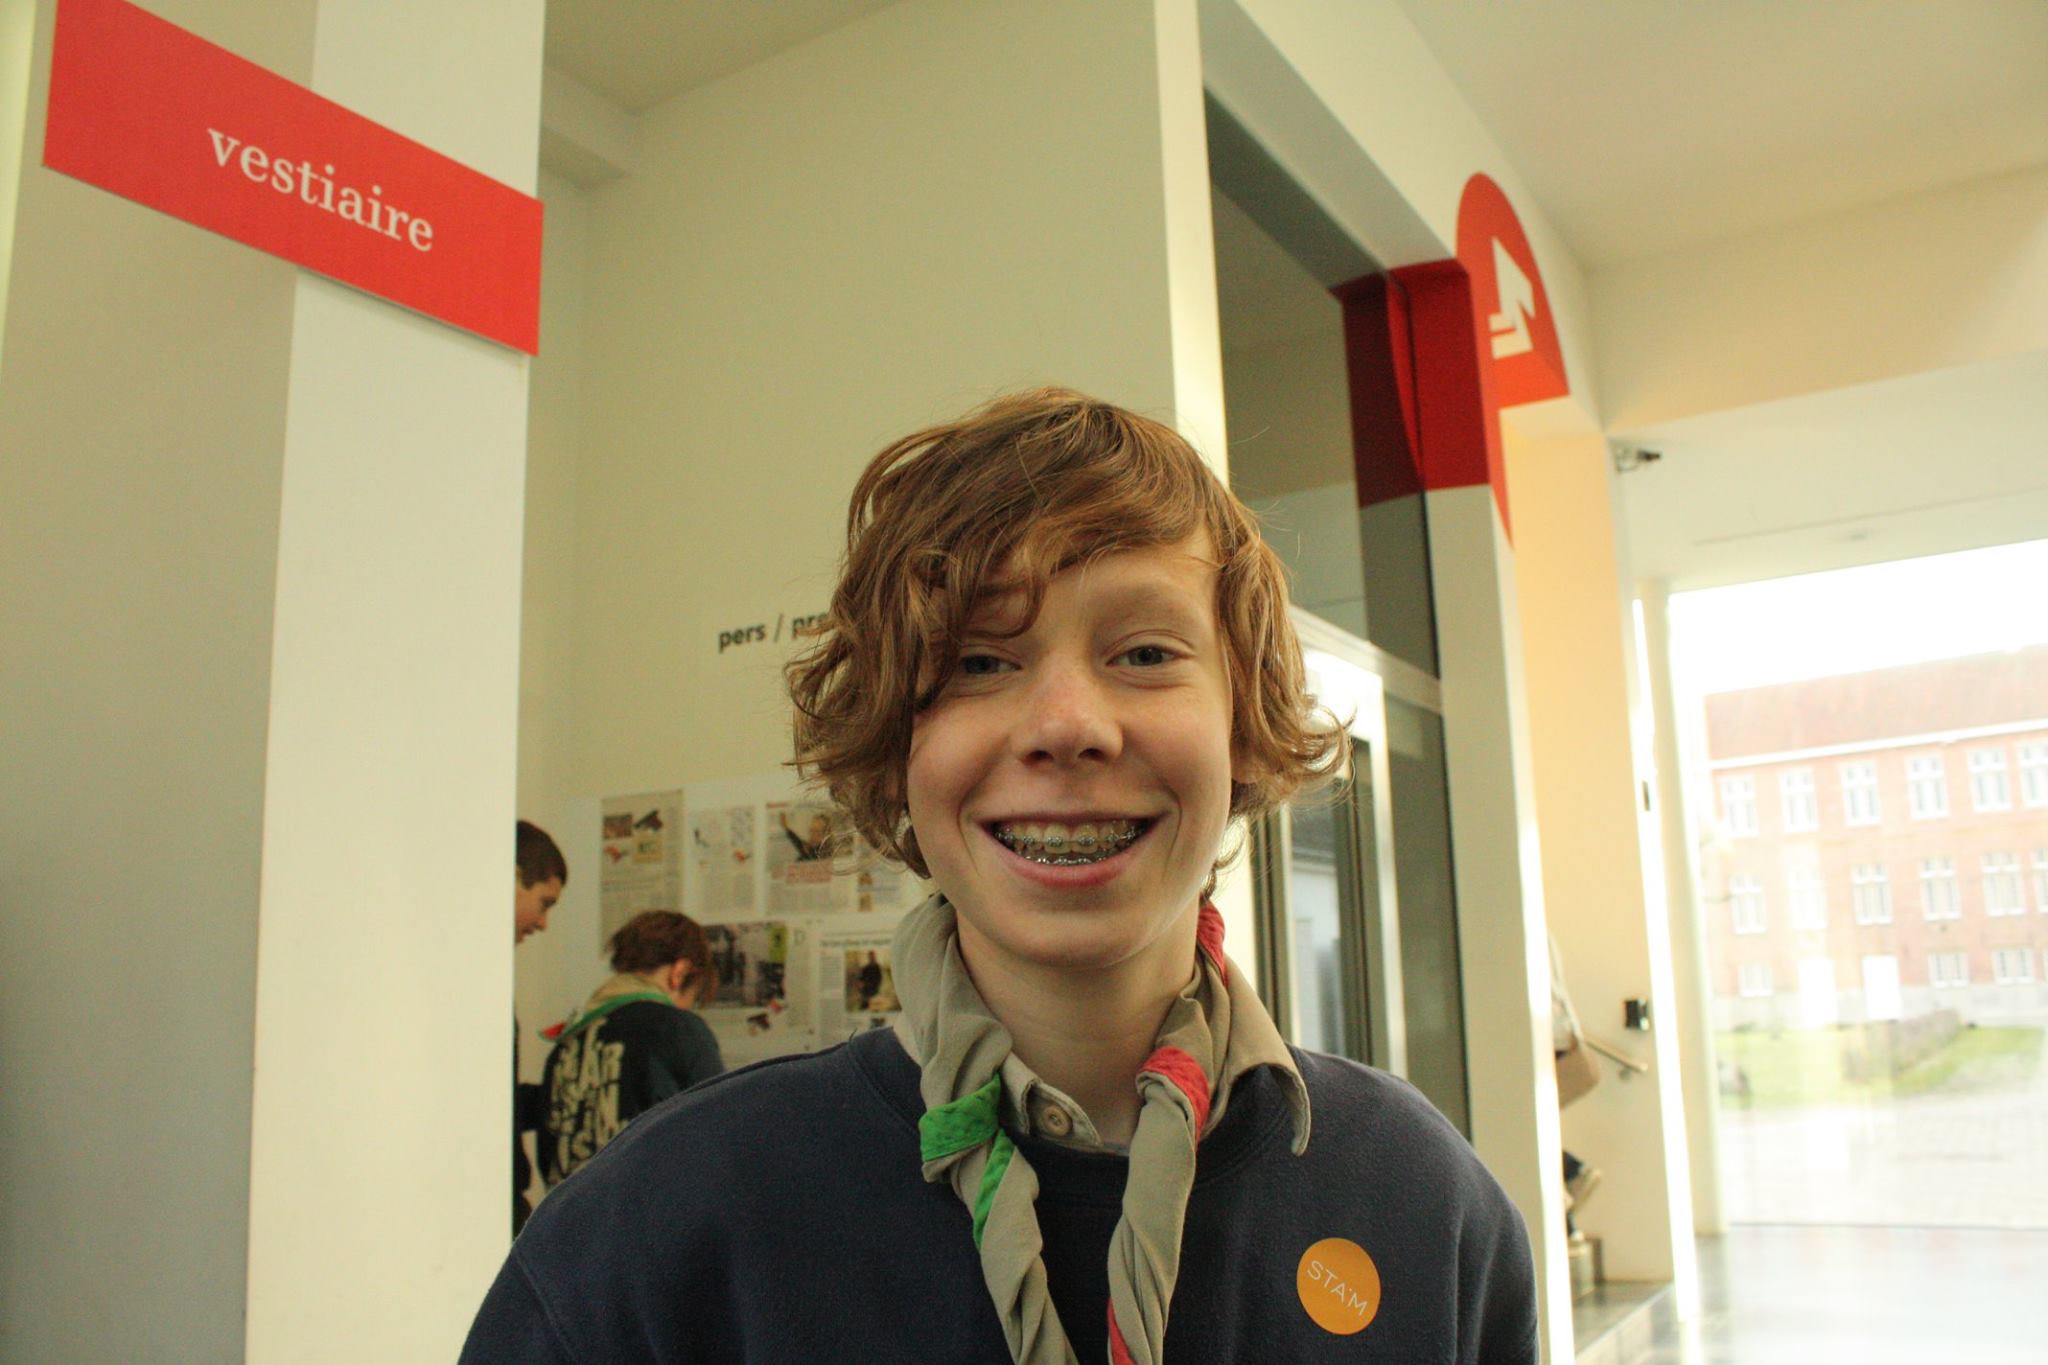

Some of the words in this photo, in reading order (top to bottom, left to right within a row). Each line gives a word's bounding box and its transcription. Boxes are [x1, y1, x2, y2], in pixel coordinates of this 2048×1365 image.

[208, 128, 433, 252] vestiaire
[719, 625, 766, 654] pers
[774, 613, 785, 643] /
[1306, 1260, 1368, 1317] STAM
